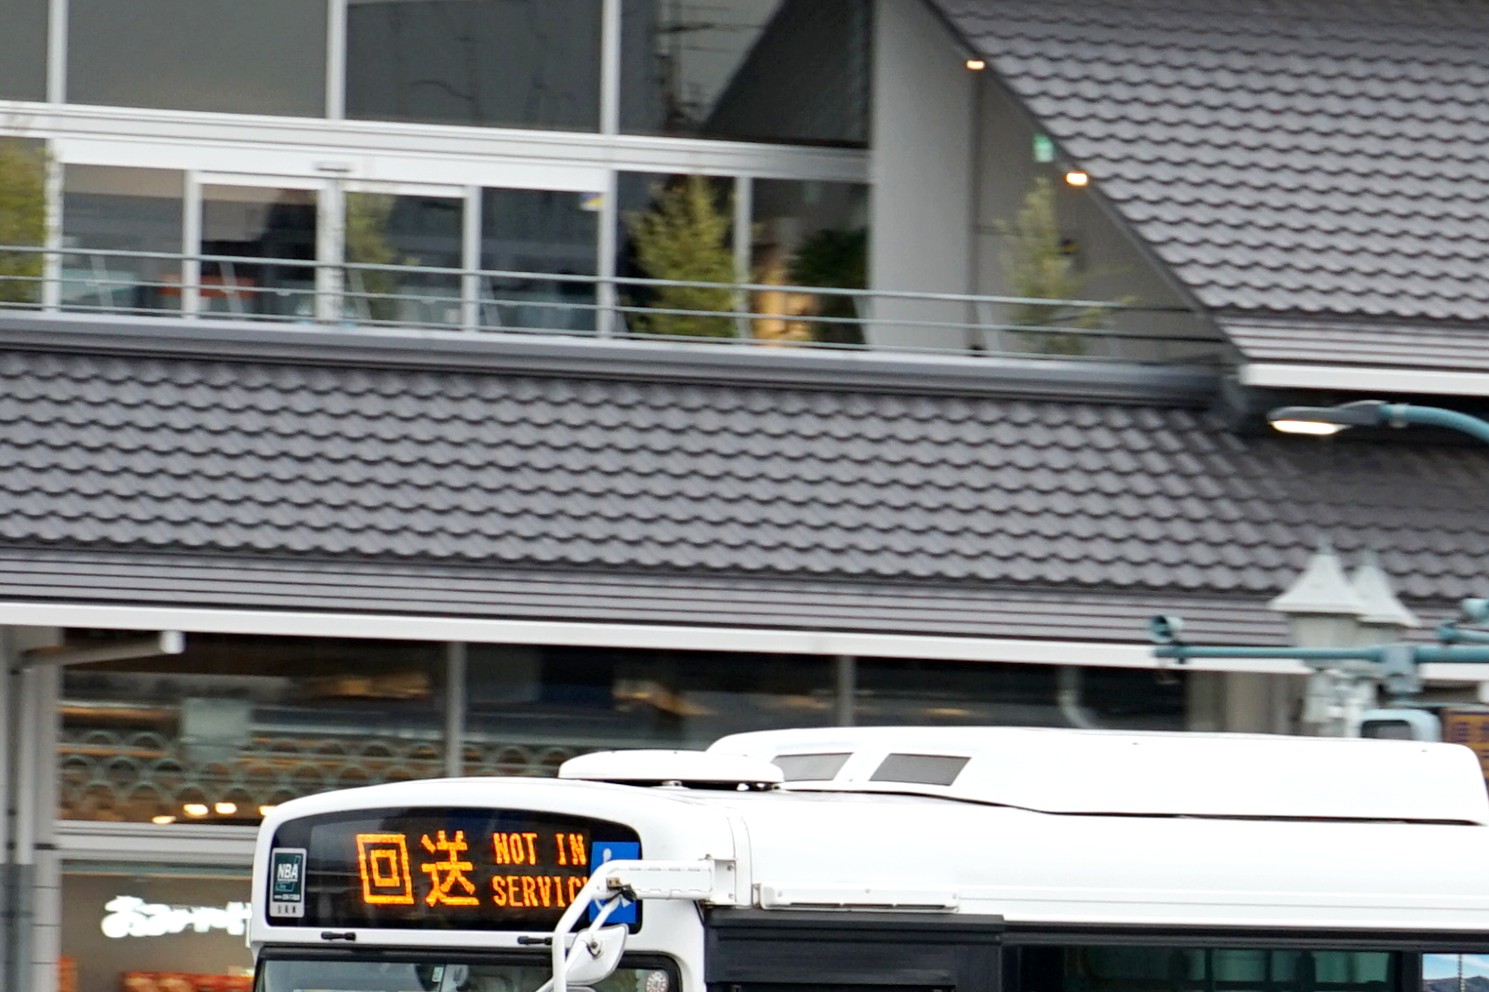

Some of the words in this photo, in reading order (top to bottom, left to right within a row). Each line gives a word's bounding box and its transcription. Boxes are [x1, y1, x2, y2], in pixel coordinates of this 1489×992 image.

[492, 832, 538, 865] NOT
[555, 832, 588, 866] IN
[277, 863, 299, 880] NBA
[355, 830, 480, 908] 回送
[491, 875, 588, 907] SERVIC
